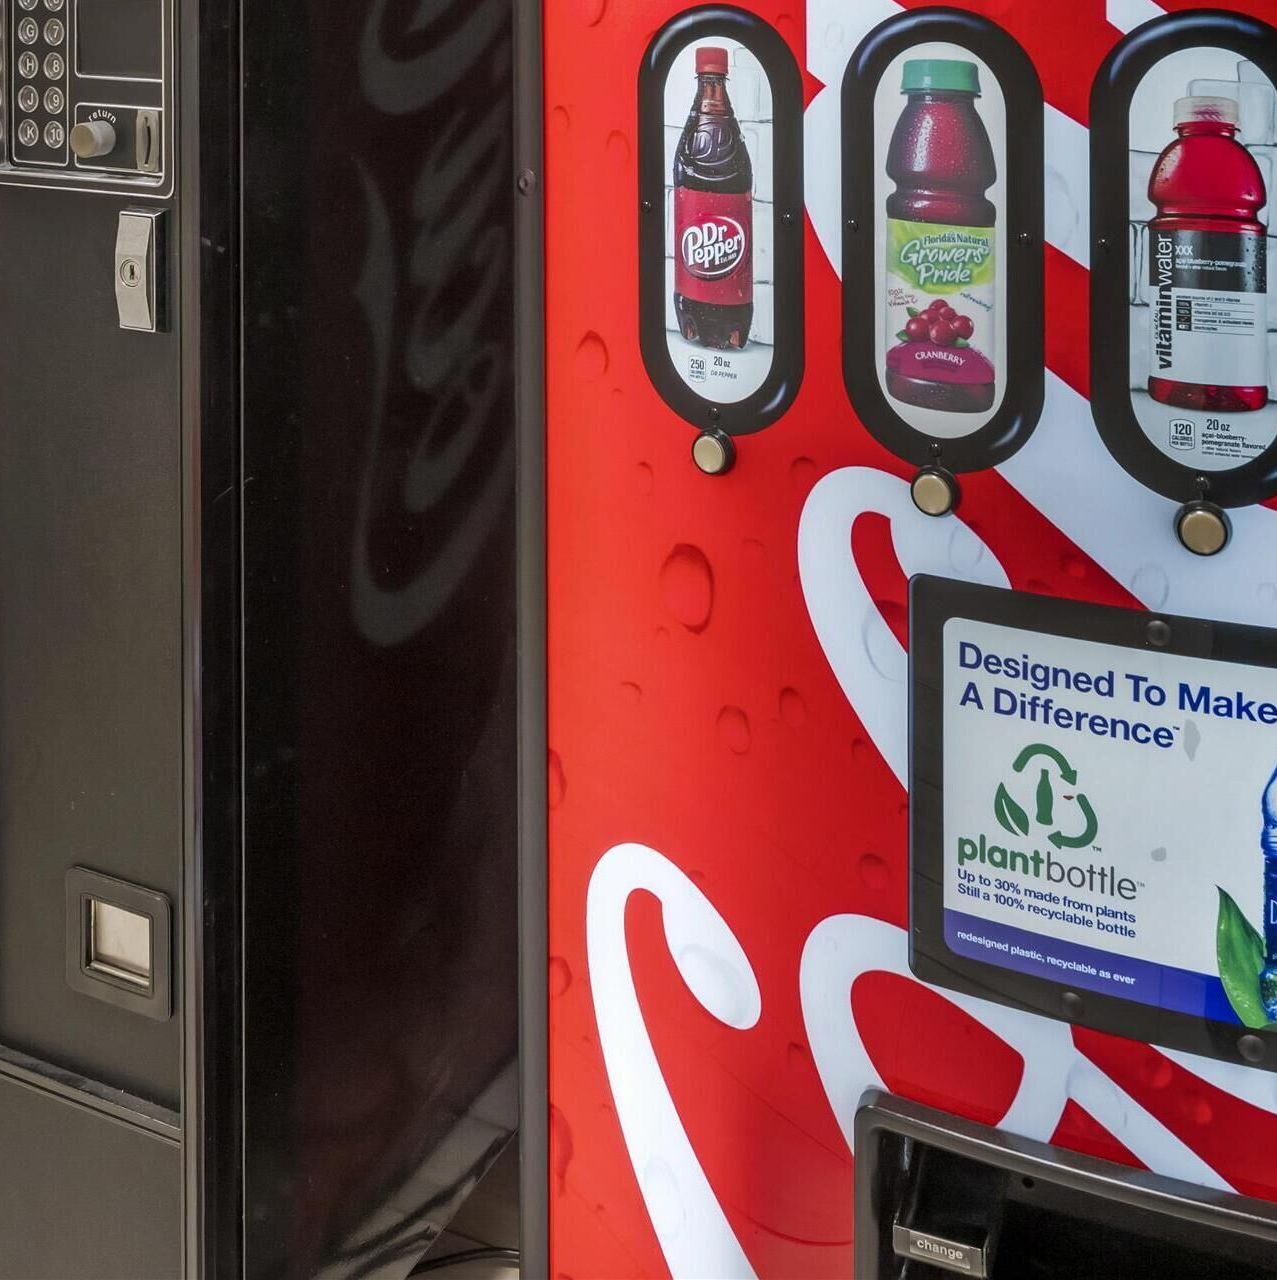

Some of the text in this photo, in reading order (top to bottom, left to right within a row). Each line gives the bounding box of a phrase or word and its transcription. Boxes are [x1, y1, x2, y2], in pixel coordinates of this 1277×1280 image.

[88, 109, 116, 123] return
[702, 222, 727, 246] Dr
[956, 234, 989, 247] Natural
[682, 226, 742, 268] Pepper
[916, 263, 971, 284] Pride
[1156, 234, 1172, 370] vitaminwater
[690, 358, 704, 370] 250
[915, 351, 966, 365] CRANBERRY
[1173, 424, 1192, 435] 120
[1206, 419, 1230, 431] 20 oz
[1202, 440, 1266, 450] pomegranate flavored
[959, 641, 1115, 698] Designed
[1125, 673, 1166, 707] To
[959, 681, 984, 711] A
[957, 868, 1136, 924] Up to 30% made from plants
[957, 883, 1136, 939] Still a 100% recyclable bottle
[957, 930, 1136, 985] redesigned plastic, recyclable as ever
[915, 1237, 964, 1262] change
